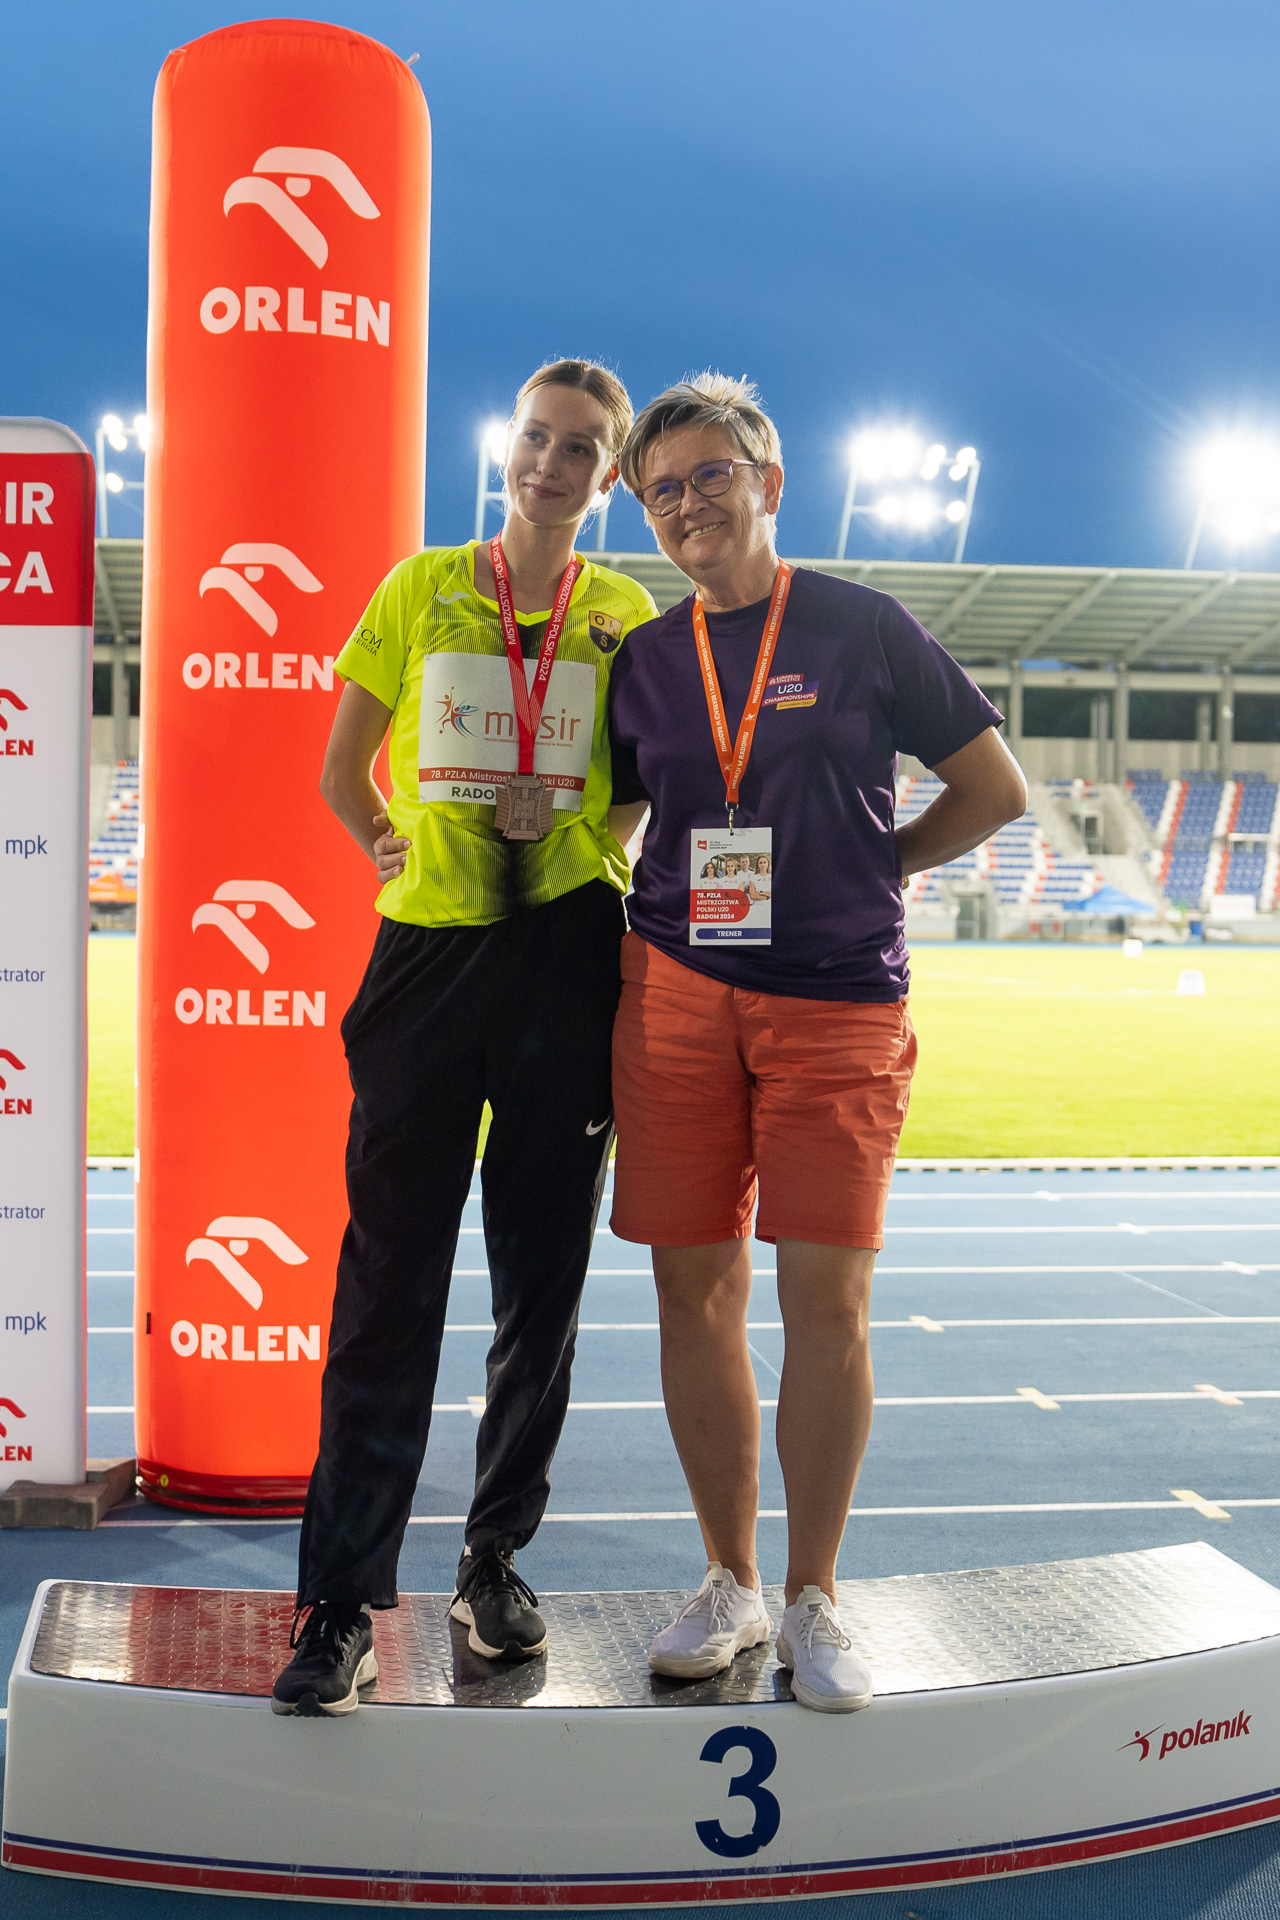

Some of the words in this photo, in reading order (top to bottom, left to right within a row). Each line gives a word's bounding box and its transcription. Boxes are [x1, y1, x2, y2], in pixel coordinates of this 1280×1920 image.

[200, 286, 390, 347] ORLEN
[0, 482, 54, 524] IR
[493, 547, 504, 579] POLSKI
[552, 564, 577, 623] MISTRZOSTWA
[498, 580, 517, 645] MISTRZOSTWA
[351, 636, 377, 656] NERGIA
[355, 625, 383, 649] CM
[545, 624, 559, 656] POLSKI
[182, 652, 334, 691] ORLEN
[538, 657, 551, 681] 2024
[752, 683, 761, 704] MIEJSKI
[763, 635, 773, 657] SPORTU
[764, 693, 815, 704] CHAMPIONSHIPS
[777, 683, 803, 694] U20
[484, 708, 581, 741] msir
[707, 671, 715, 691] SPORTU
[711, 694, 721, 721] REKREACJI
[717, 725, 727, 752] RADOMIU
[739, 731, 749, 760] RADOMIU
[430, 770, 443, 779] 78.
[445, 771, 466, 779] PZLA
[469, 771, 514, 782] Mistrzost
[540, 776, 556, 786] ski
[557, 778, 576, 787] U20
[451, 786, 495, 800] RADO
[5, 835, 48, 859] mpk
[175, 987, 326, 1026] ORLEN
[0, 1098, 32, 1115] EN
[5, 1312, 47, 1335] mpk
[170, 1320, 321, 1361] ORLEN
[1158, 1709, 1252, 1761] polanik
[694, 1725, 781, 1859] 3
